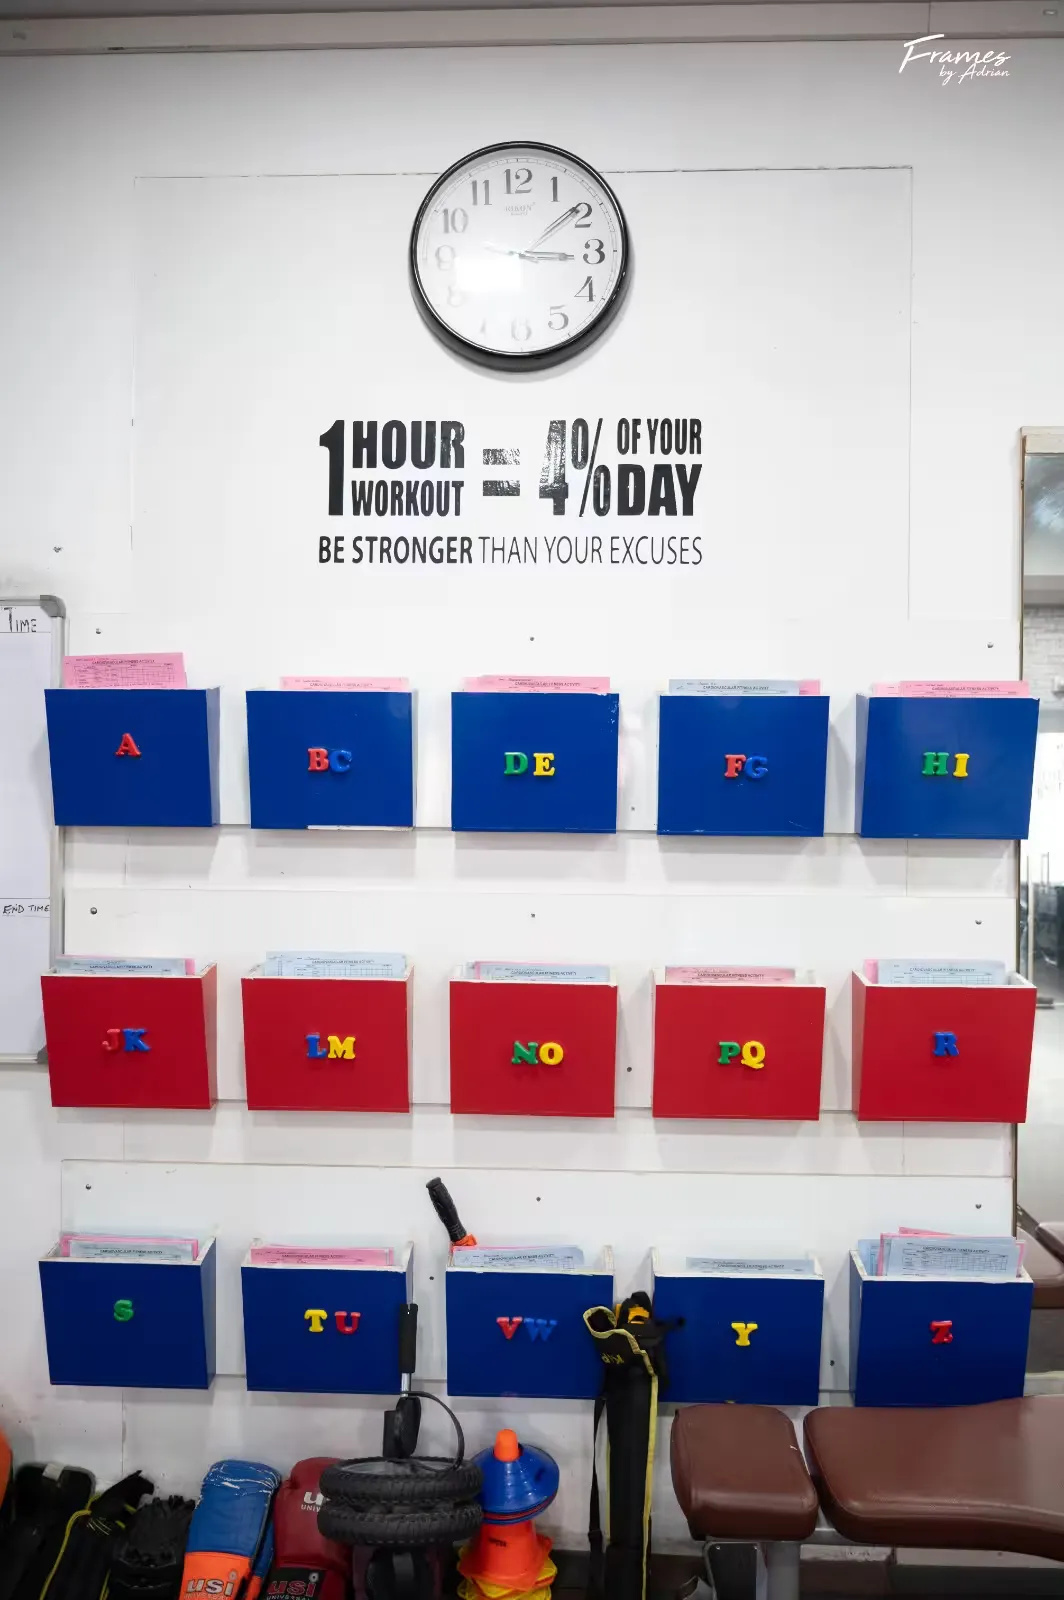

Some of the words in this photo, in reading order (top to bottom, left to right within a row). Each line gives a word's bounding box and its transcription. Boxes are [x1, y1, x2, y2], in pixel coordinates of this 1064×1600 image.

[471, 180, 492, 206] 11
[503, 168, 533, 194] 12
[551, 176, 561, 203] 1
[442, 207, 469, 234] 10
[573, 202, 593, 228] 2
[582, 238, 605, 265] 3
[574, 275, 596, 302] 4
[548, 304, 569, 331] 5
[617, 418, 642, 455] OF
[647, 418, 702, 455] YOUR
[319, 419, 345, 516] 1
[352, 419, 465, 469] HOUR
[351, 479, 465, 517] WORKOUT
[617, 464, 702, 517] DAY
[319, 536, 345, 564] BE
[352, 536, 473, 564] STRONGER
[478, 536, 537, 564] THAN
[543, 536, 602, 564] YOUR
[610, 536, 702, 564] EXCUSES
[115, 733, 141, 758] A
[3, 904, 24, 914] END
[28, 904, 50, 912] TIME
[933, 1031, 960, 1057] R
[113, 1299, 134, 1322] S
[731, 1321, 758, 1346] Y
[930, 1320, 953, 1344] Z
